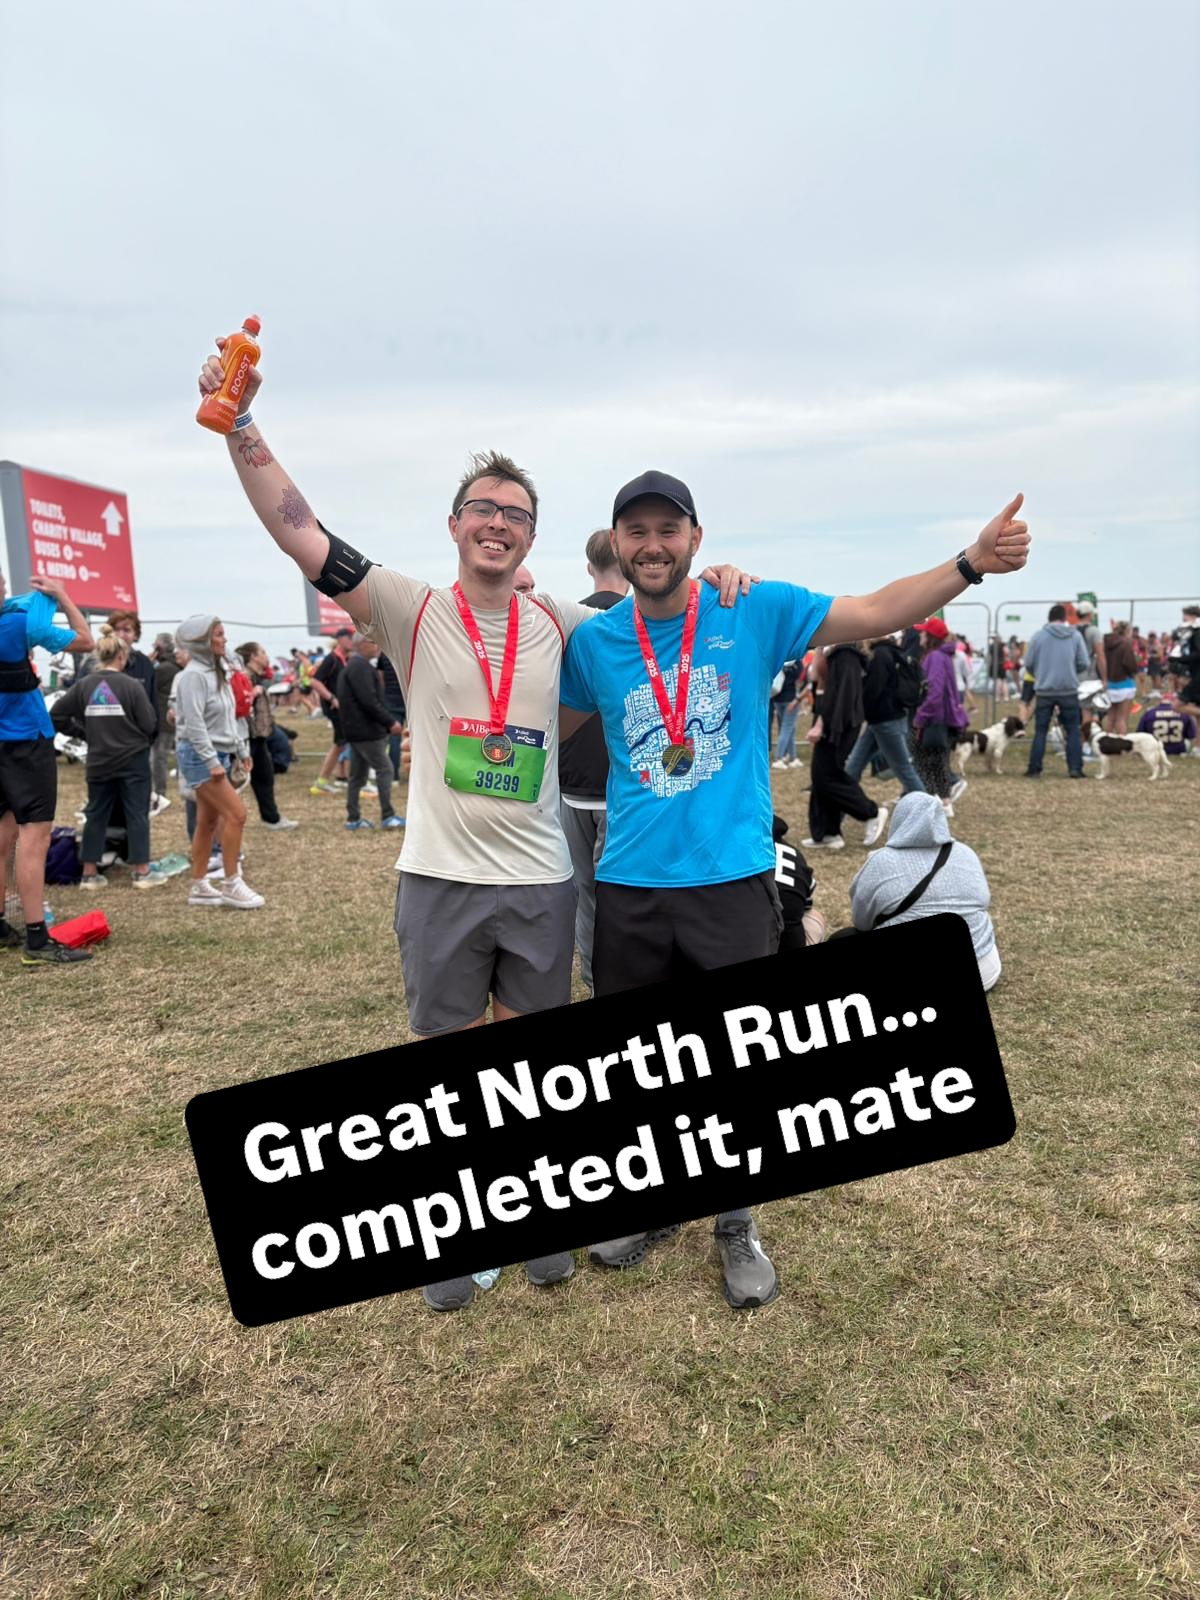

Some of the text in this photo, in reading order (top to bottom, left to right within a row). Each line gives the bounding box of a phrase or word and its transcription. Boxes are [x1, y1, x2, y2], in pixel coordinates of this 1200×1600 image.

[230, 354, 252, 396] BOOST
[32, 519, 106, 551] CHARITY VILLAGE,
[34, 539, 60, 559] BUSES
[37, 560, 77, 580] & METRO
[474, 640, 486, 659] 2025
[646, 657, 659, 678] 2025
[680, 653, 690, 674] 2025
[1153, 720, 1184, 743] 23
[630, 760, 663, 773] LOVE
[475, 770, 520, 793] 39299
[774, 842, 797, 887] E
